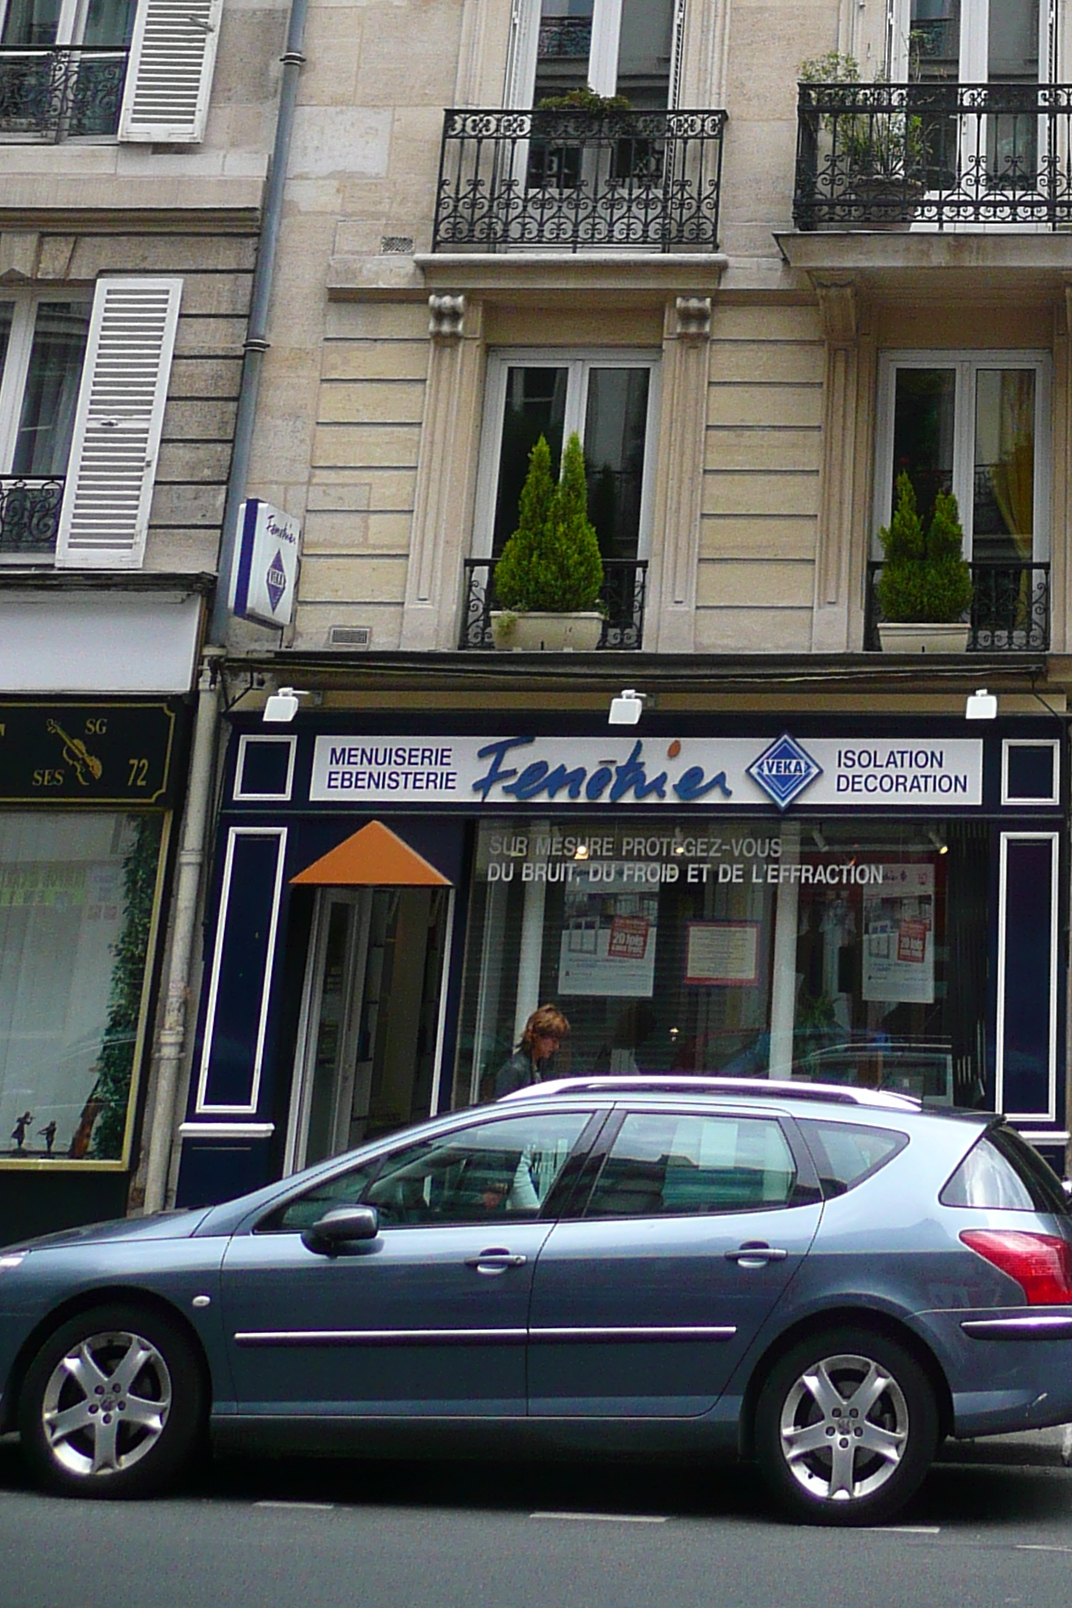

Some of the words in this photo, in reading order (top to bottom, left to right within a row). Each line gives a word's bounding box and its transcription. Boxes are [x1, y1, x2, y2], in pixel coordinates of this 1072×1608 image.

[85, 718, 108, 735] SG
[329, 747, 453, 766] MENUISERIE
[837, 750, 944, 768] ISOLATION
[127, 758, 149, 787] 72
[765, 760, 804, 775] VEKA
[326, 771, 458, 790] EBENISTERIE
[836, 774, 968, 793] DECORATION
[488, 836, 529, 857] SUR
[535, 837, 614, 857] MESURE
[487, 862, 515, 882] DU
[521, 862, 581, 886] BRUIT,
[588, 863, 616, 882] DU
[622, 863, 680, 883] FROID
[687, 864, 712, 883] ET
[718, 864, 744, 883] DE
[751, 864, 884, 885] L'EFFRACTION
